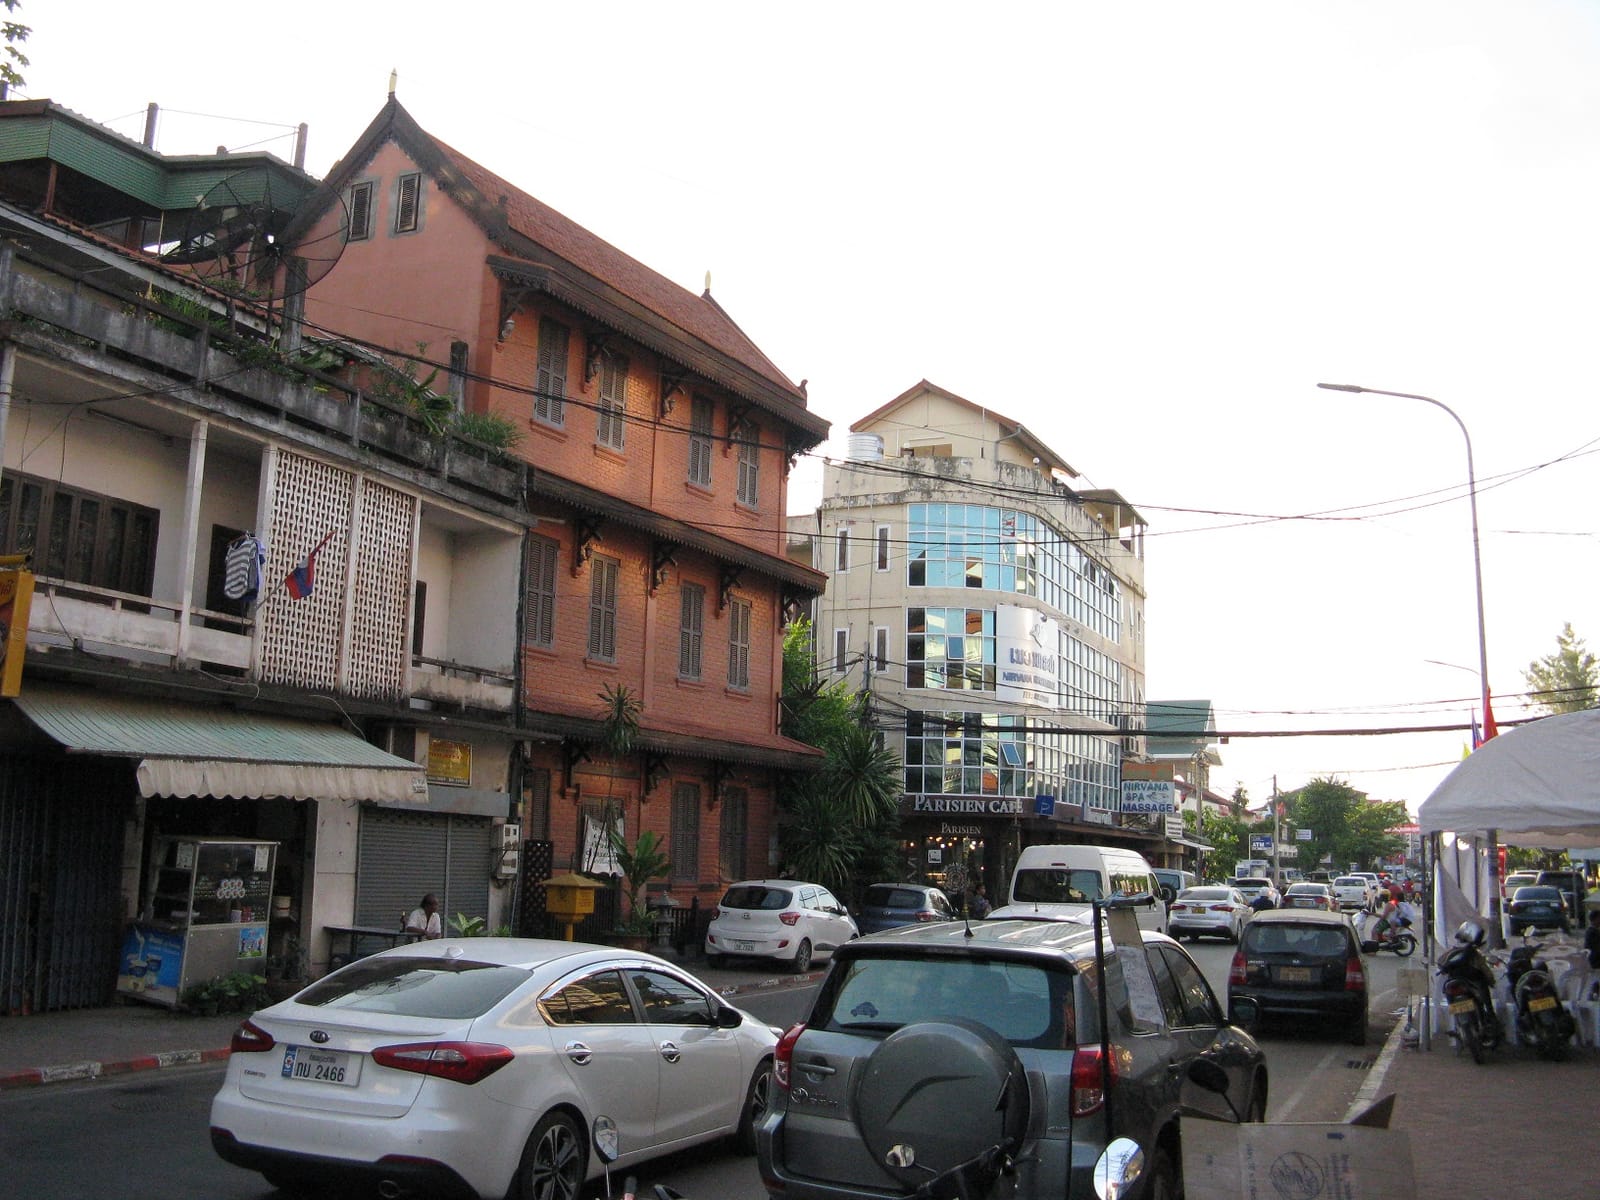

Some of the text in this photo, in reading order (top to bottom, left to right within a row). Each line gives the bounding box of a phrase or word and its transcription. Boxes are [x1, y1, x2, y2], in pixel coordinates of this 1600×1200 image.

[1123, 782, 1169, 792] NIRVANA
[1126, 792, 1145, 801] SPA
[913, 793, 985, 813] PARISIEN
[1122, 803, 1173, 813] MASSAGE
[940, 822, 981, 834] PARISIEN
[315, 1065, 345, 1082] 2466
